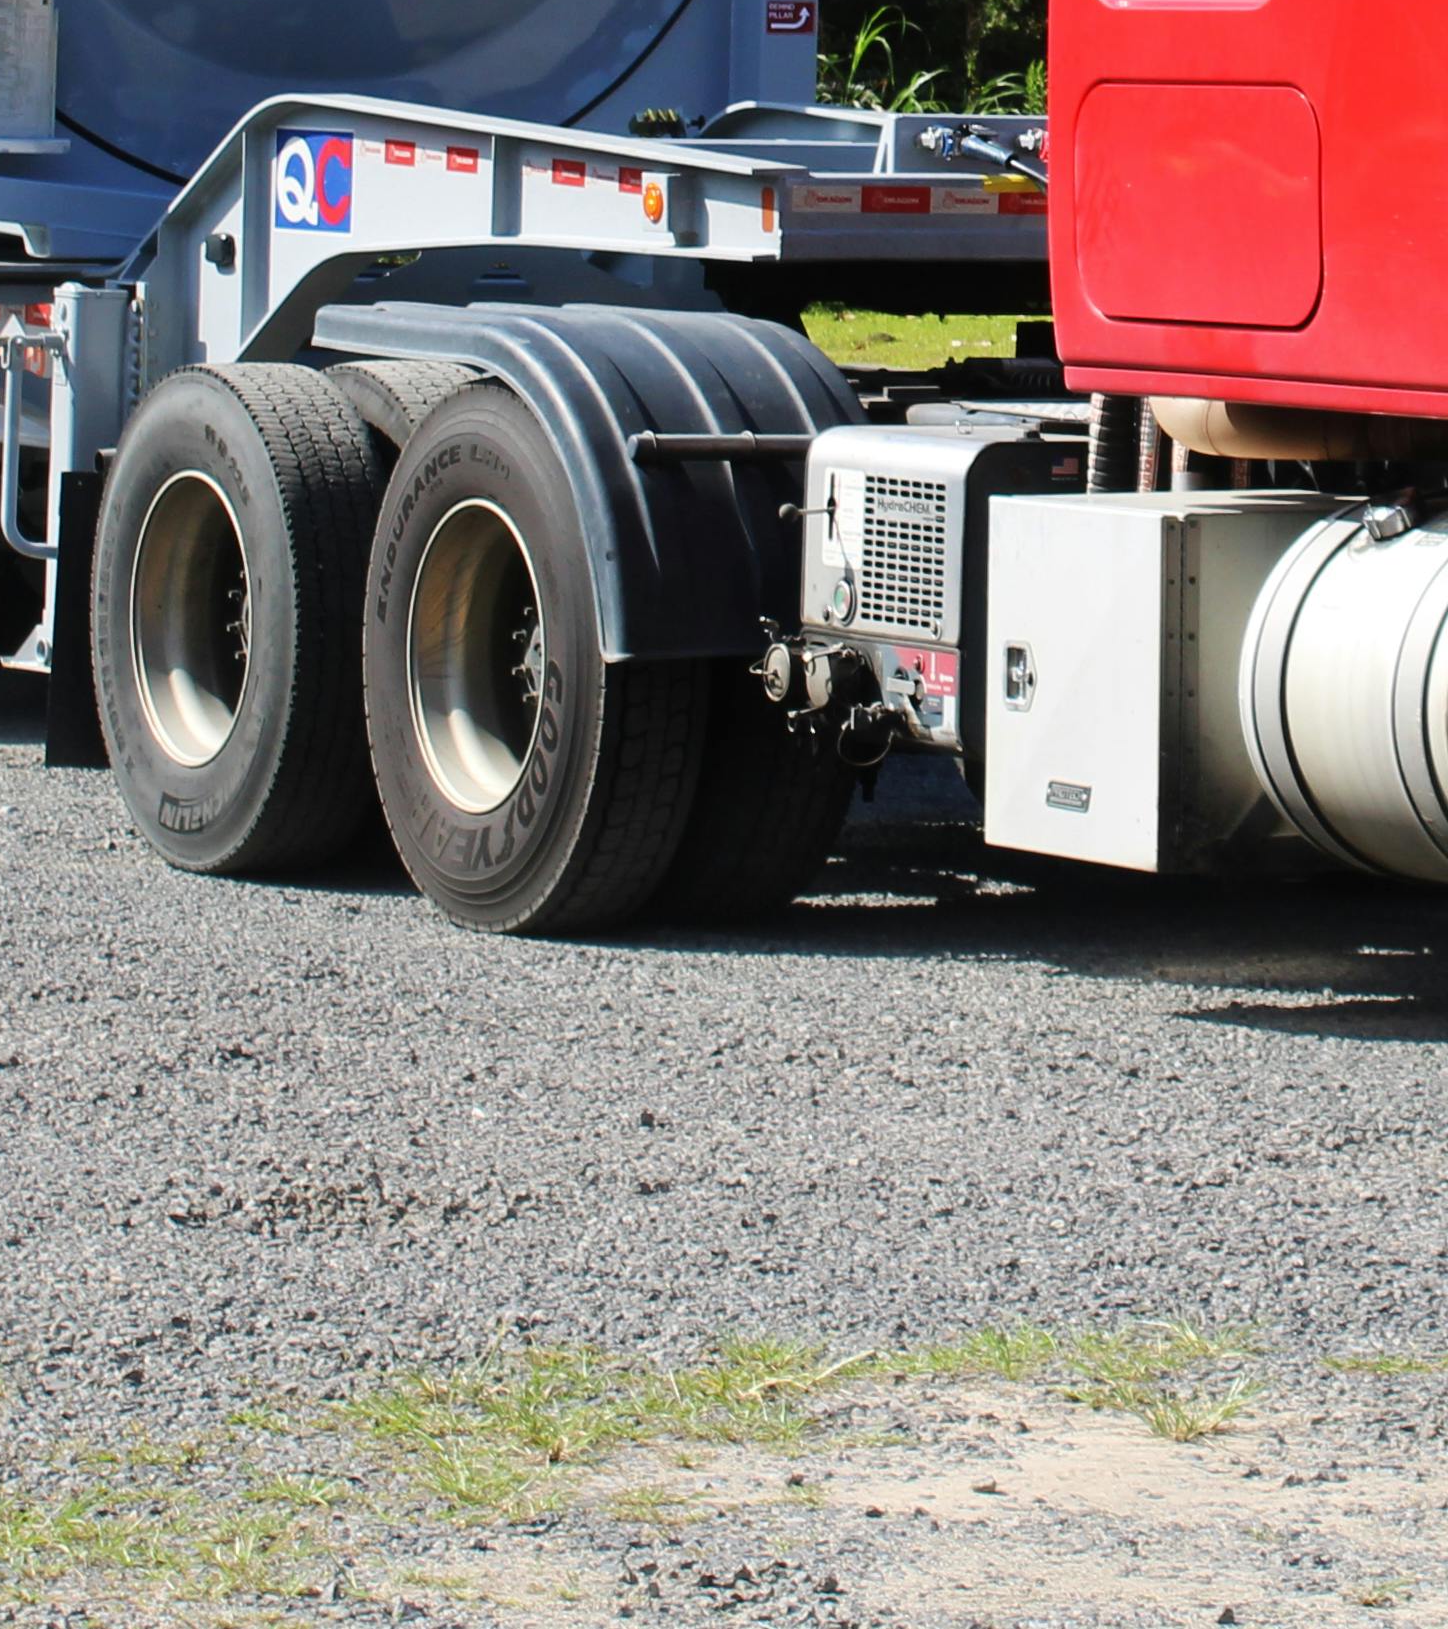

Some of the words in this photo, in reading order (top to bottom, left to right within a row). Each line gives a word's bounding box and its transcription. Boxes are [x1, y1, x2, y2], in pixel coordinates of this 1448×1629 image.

[276, 137, 352, 227] QC
[376, 443, 462, 625] ENDURANCE
[412, 659, 563, 872] GOODYEAR
